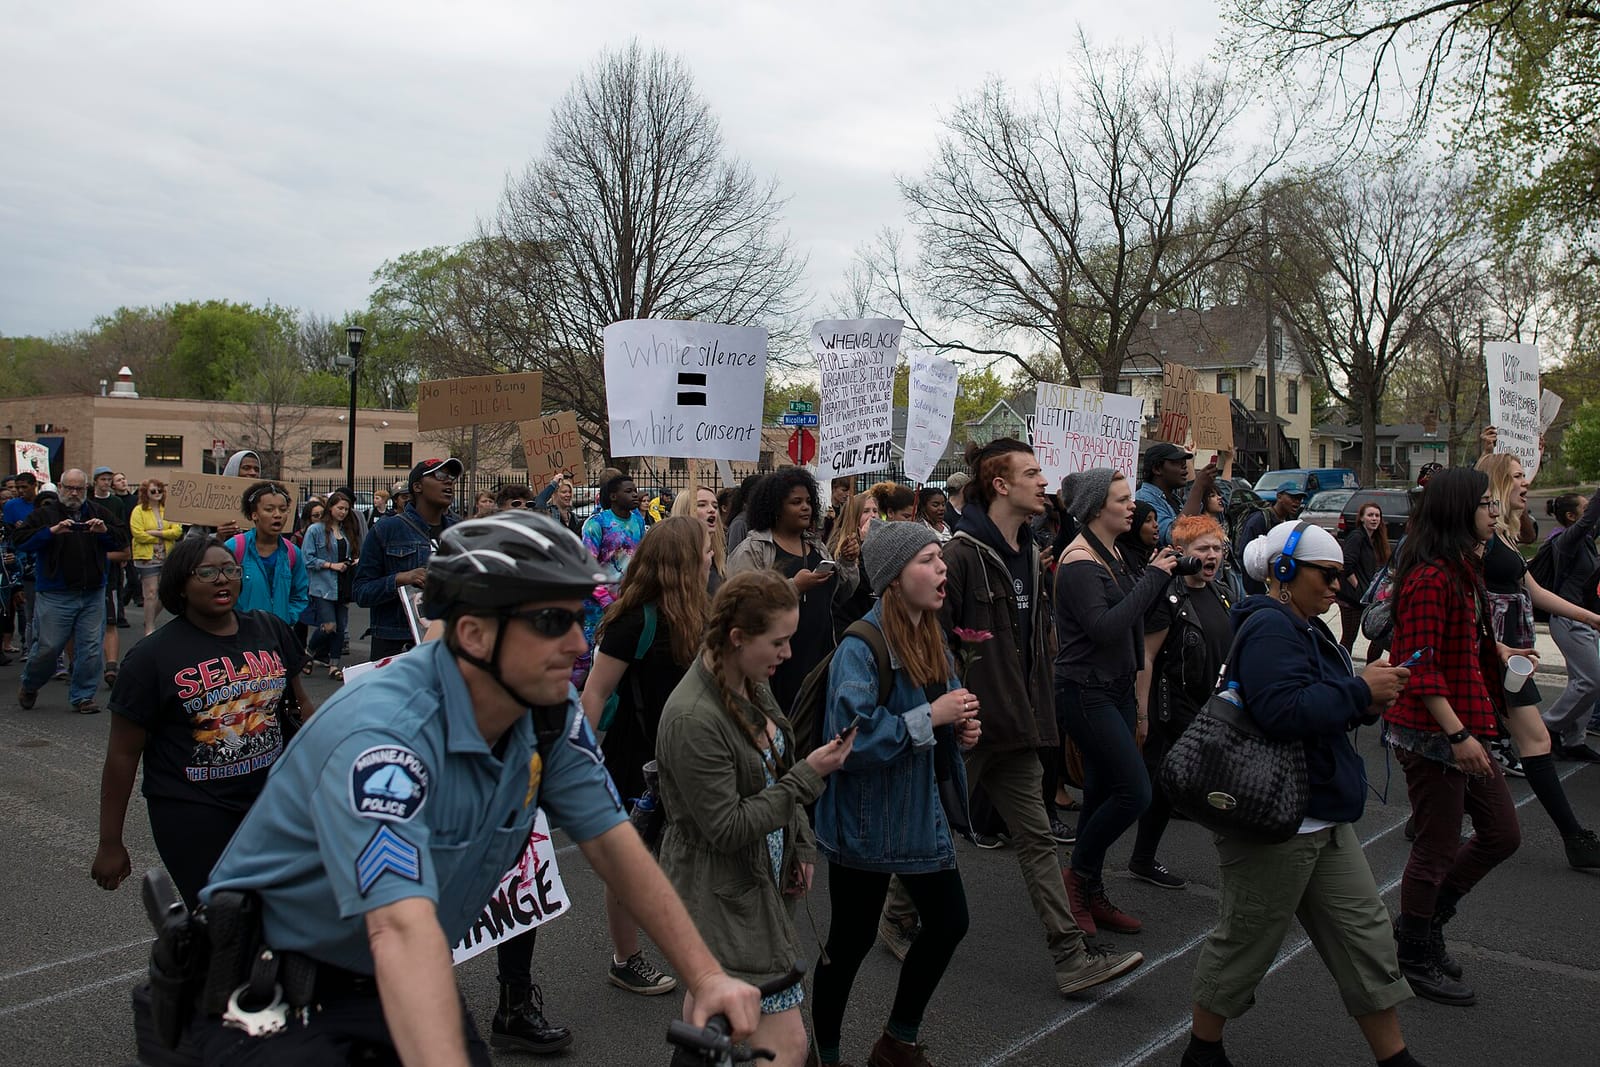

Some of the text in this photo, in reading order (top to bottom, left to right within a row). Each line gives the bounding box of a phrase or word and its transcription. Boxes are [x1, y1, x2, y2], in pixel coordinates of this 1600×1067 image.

[620, 334, 757, 368] White silence
[819, 332, 899, 350] WHEN BLACK
[816, 352, 849, 371] PEOPLE
[496, 378, 526, 394] Being
[823, 370, 859, 388] ORGANIZE
[860, 368, 867, 383] &
[869, 367, 885, 381] TAKE
[886, 366, 896, 379] UP
[1164, 362, 1198, 393] BLACK
[821, 380, 892, 402] ARMS TO FIGHT FOR OUR
[1038, 384, 1105, 414] JUSTICE FOR
[821, 391, 892, 416] LIBERATION THERE WILL BE
[859, 405, 874, 417] PEOPLE
[1192, 392, 1212, 416] OUR
[543, 418, 560, 435] NO
[622, 409, 685, 447] White
[785, 416, 816, 424] Nicollet Av
[821, 416, 889, 441] WILL DROP DEAD FROM
[1042, 407, 1062, 427] LEFT
[1062, 409, 1074, 431] IT
[1073, 411, 1100, 435] BLANK
[1100, 414, 1139, 442] BECAUSE
[526, 431, 577, 456] JUSTICE
[1035, 428, 1054, 445] I'LL
[1065, 431, 1113, 455] PROBABLY
[1112, 439, 1134, 457] NEED
[547, 451, 564, 469] NO
[832, 449, 858, 474] GUILT
[863, 440, 892, 465] FEAR
[1034, 445, 1060, 467] THIS
[1070, 451, 1105, 473] NEXT
[183, 697, 203, 714] TO
[186, 767, 208, 781] THE
[209, 759, 251, 780] DREAM
[361, 797, 407, 817] POLICE
